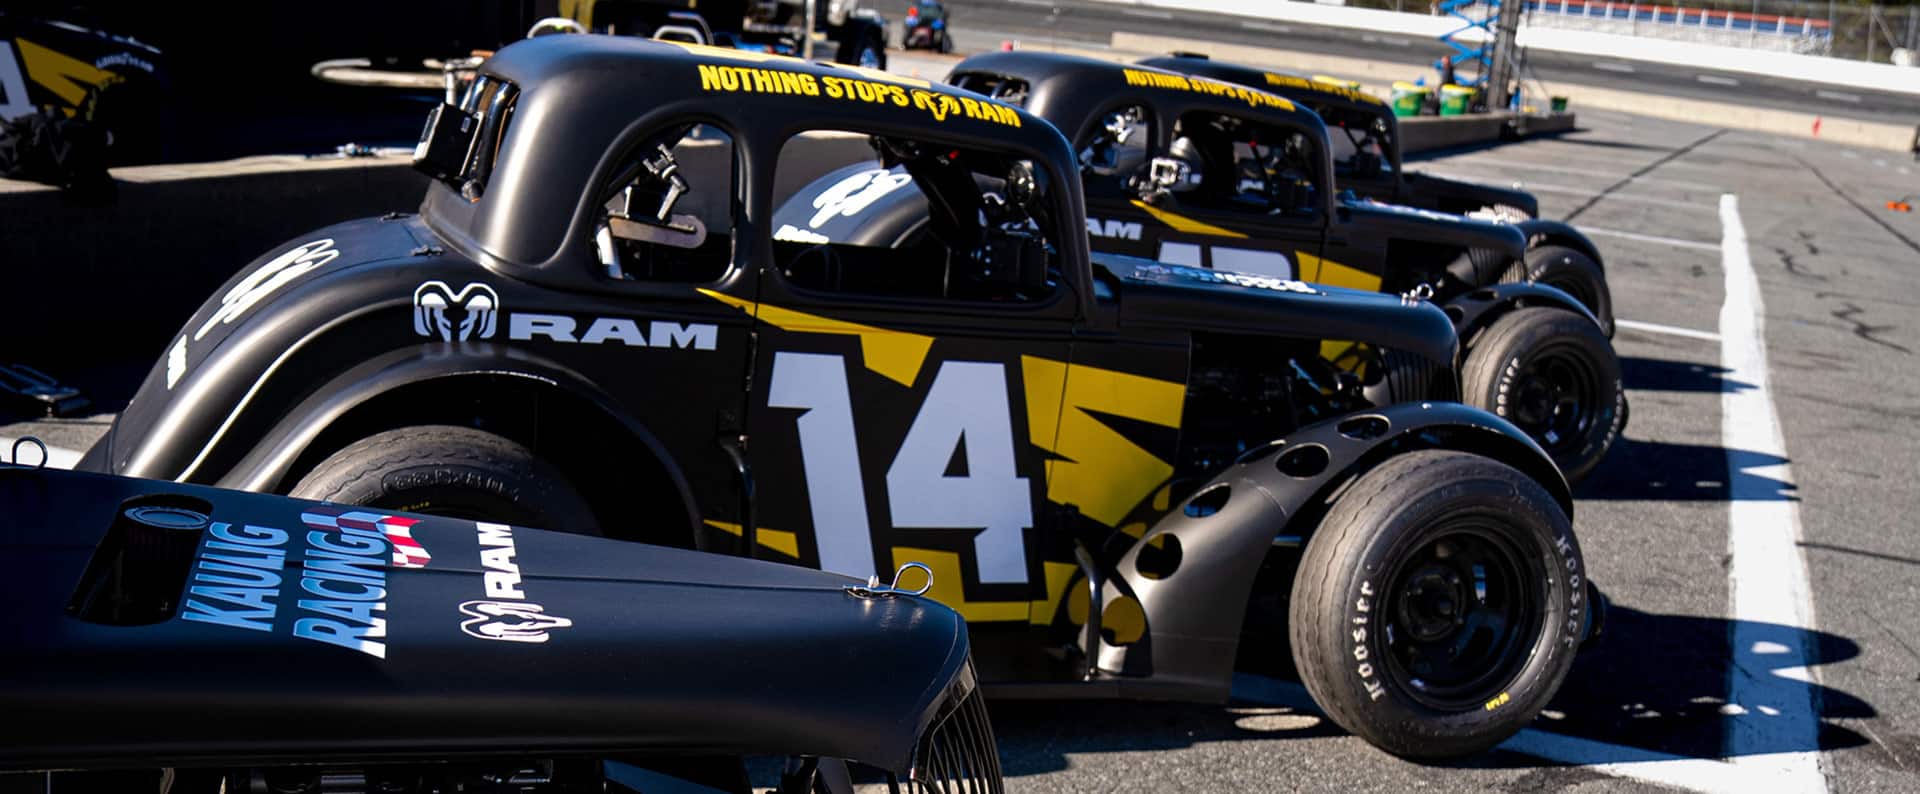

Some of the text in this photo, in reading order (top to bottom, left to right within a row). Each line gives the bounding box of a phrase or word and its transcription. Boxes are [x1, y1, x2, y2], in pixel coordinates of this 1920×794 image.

[698, 65, 1022, 128] NOTHING STOPS RAM
[1087, 218, 1142, 240] AM
[510, 313, 718, 351] RAM
[767, 351, 1034, 584] 14
[181, 521, 290, 633] KAULIG
[293, 529, 388, 660] RACING
[475, 522, 526, 599] RAM
[1353, 581, 1386, 701] Hoosier
